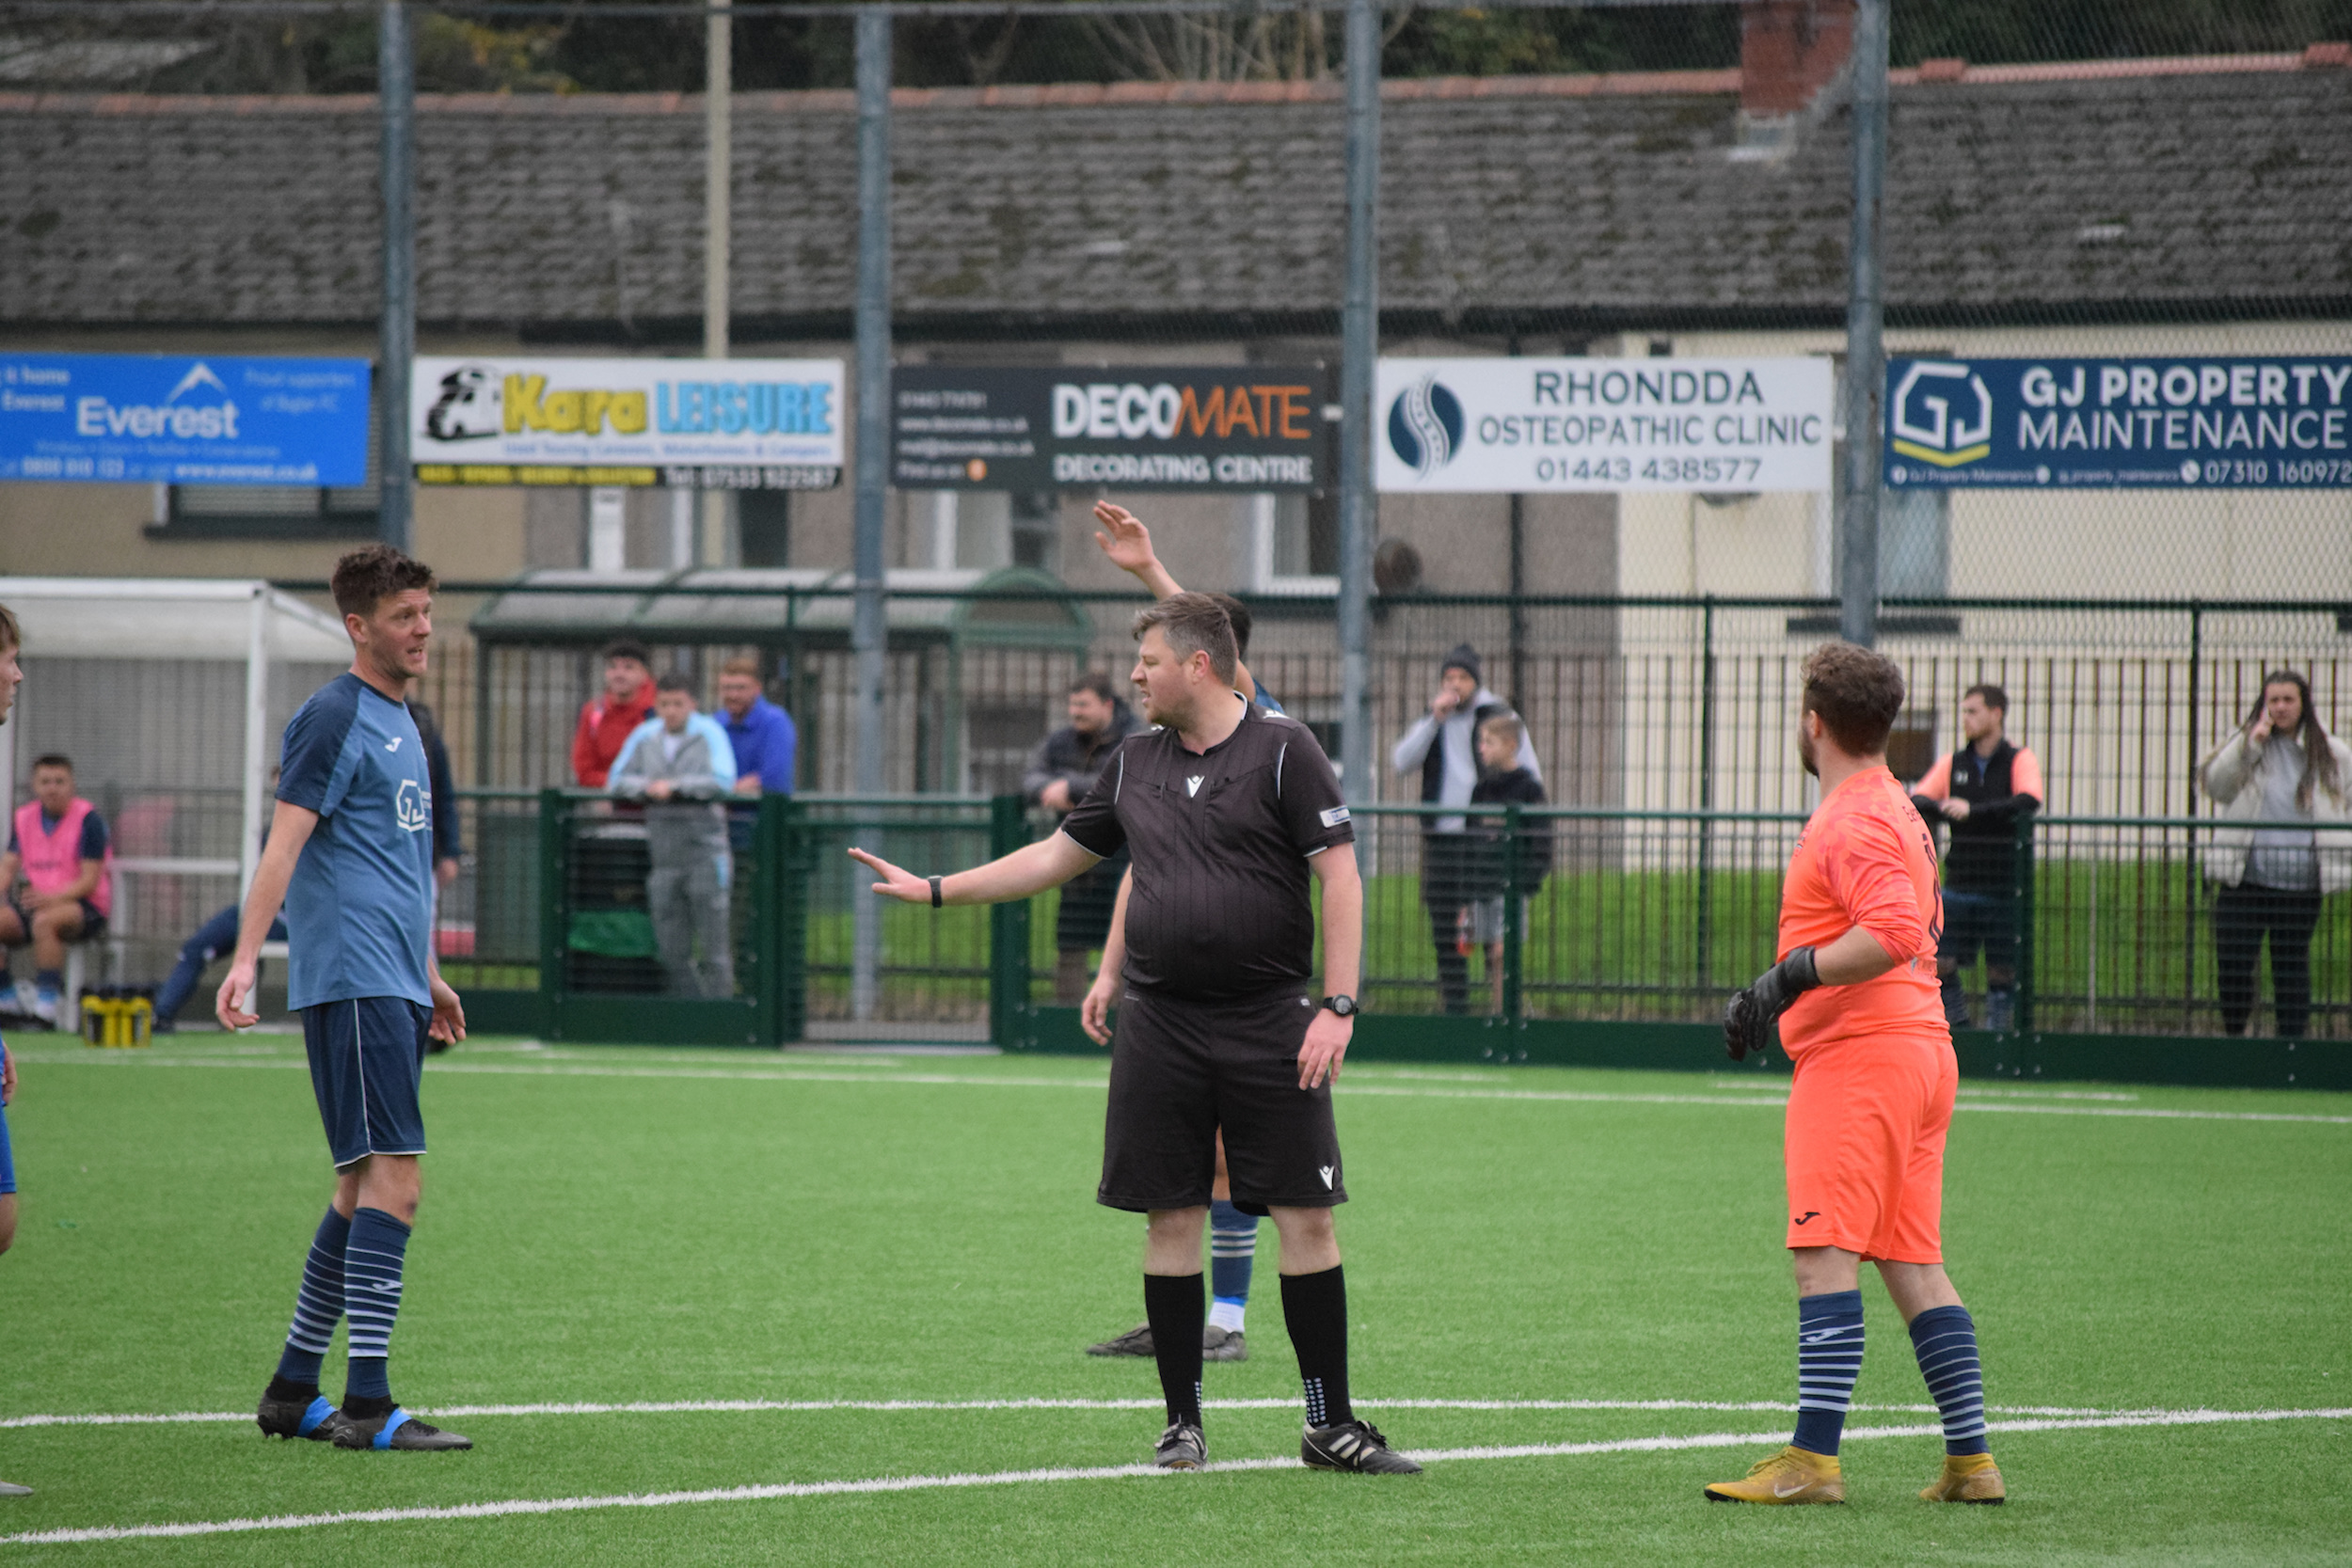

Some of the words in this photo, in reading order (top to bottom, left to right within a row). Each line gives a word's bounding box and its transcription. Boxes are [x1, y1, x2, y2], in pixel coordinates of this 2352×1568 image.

[502, 373, 647, 436] Kara
[656, 382, 834, 435] LEISURE
[1534, 370, 1765, 404] RHONDDA
[2021, 365, 2086, 407] GJ
[2099, 364, 2352, 407] PROPERTY
[75, 394, 240, 439] Everest
[1053, 383, 1311, 438] DECOMATE
[1478, 414, 1705, 447] OSTEOPATHIC
[1714, 414, 1822, 447] CLINIC
[2017, 409, 2348, 451] MAINTENANCE
[1053, 453, 1211, 482] DECORATING
[1214, 453, 1313, 483] CENTRE
[1536, 456, 1632, 483] 01443
[1641, 456, 1763, 483] 438577
[2204, 460, 2268, 483] 07310
[2277, 459, 2352, 483] 160972
